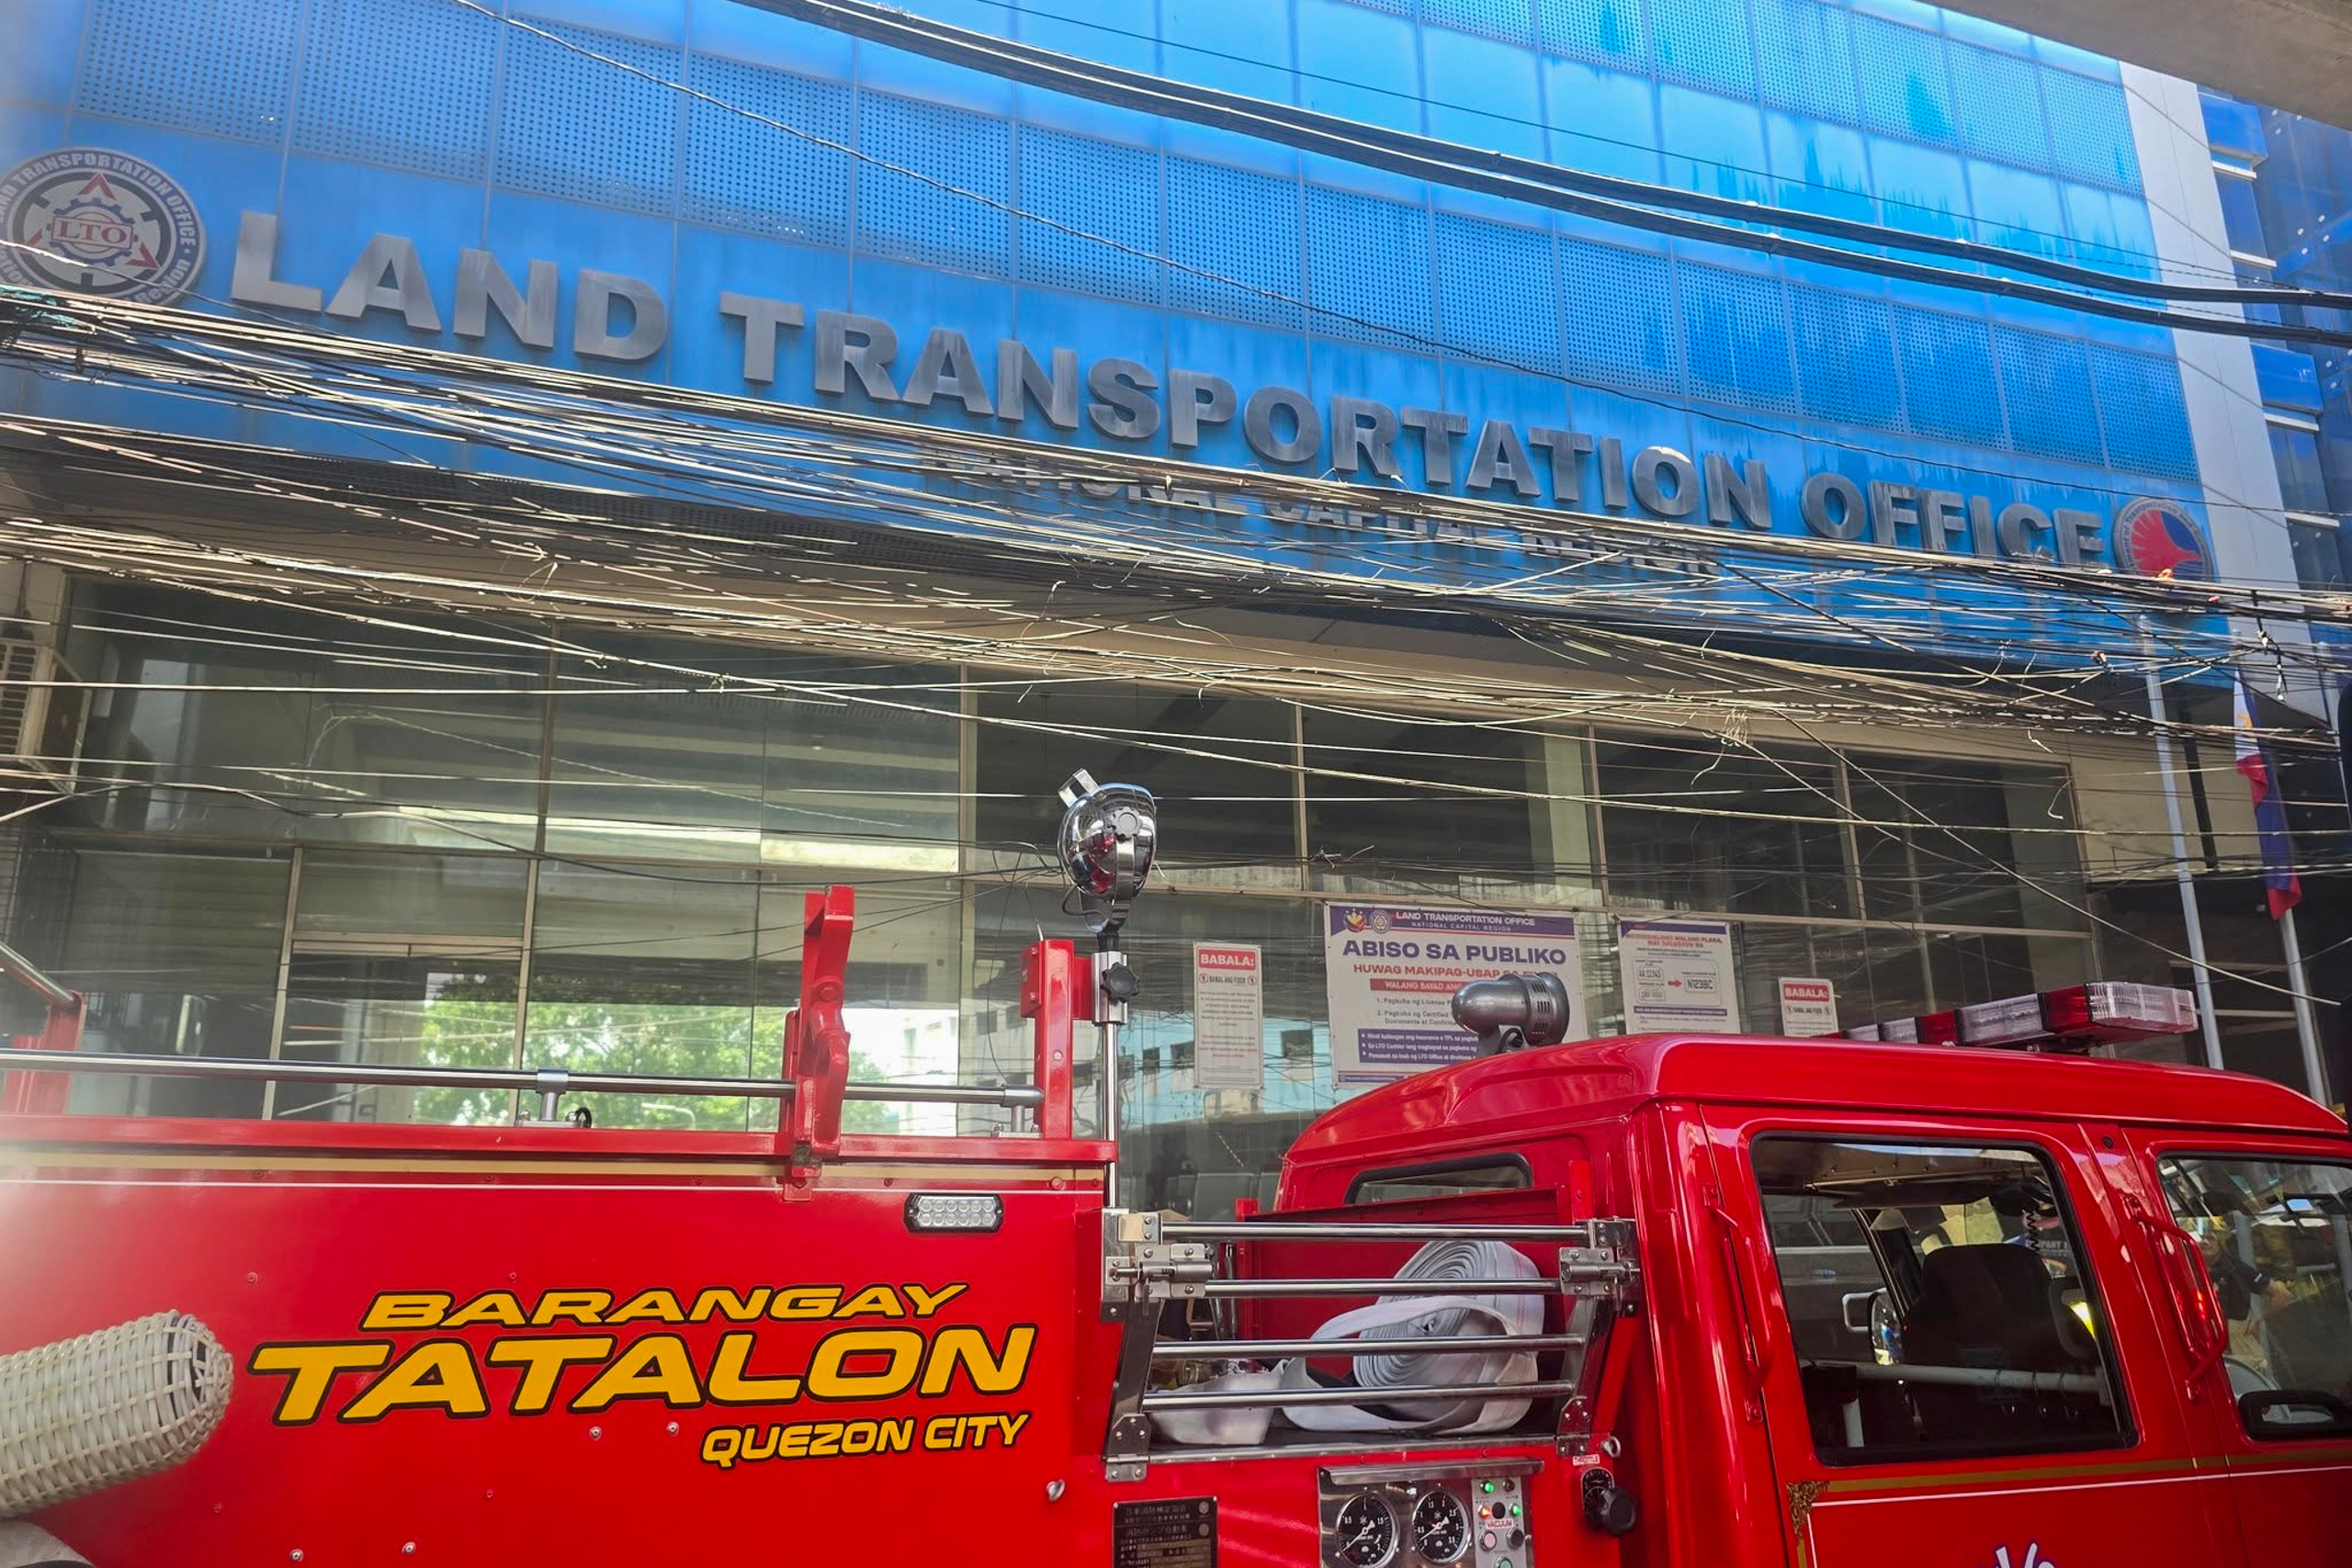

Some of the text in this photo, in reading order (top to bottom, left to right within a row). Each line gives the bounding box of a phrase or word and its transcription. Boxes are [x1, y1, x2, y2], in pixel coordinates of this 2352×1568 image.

[12, 152, 175, 196] TRANSPORTATION
[166, 192, 196, 246] OFFICE
[59, 220, 128, 244] LTO
[231, 211, 669, 362] LAND
[720, 292, 1773, 531] TRANSPORTATION
[1801, 472, 2105, 568] OFFICE
[1396, 911, 1535, 927] LAND TRANSPORTATION OFFICE
[1201, 953, 1254, 966] BABALA:
[1342, 940, 1566, 964] ABISO SA PUBLIKO
[1353, 964, 1402, 975] HUWAG
[1405, 965, 1500, 978] MAKIPAG-USAP
[1385, 981, 1463, 991] WALANG BAYAD ANG
[1784, 987, 1828, 998] BABALA:
[360, 1282, 968, 1331] BARANGAY
[249, 1324, 1039, 1425] TATALON
[700, 1413, 1030, 1470] QUEZON CITY
[1487, 1519, 1512, 1528] VACUUM
